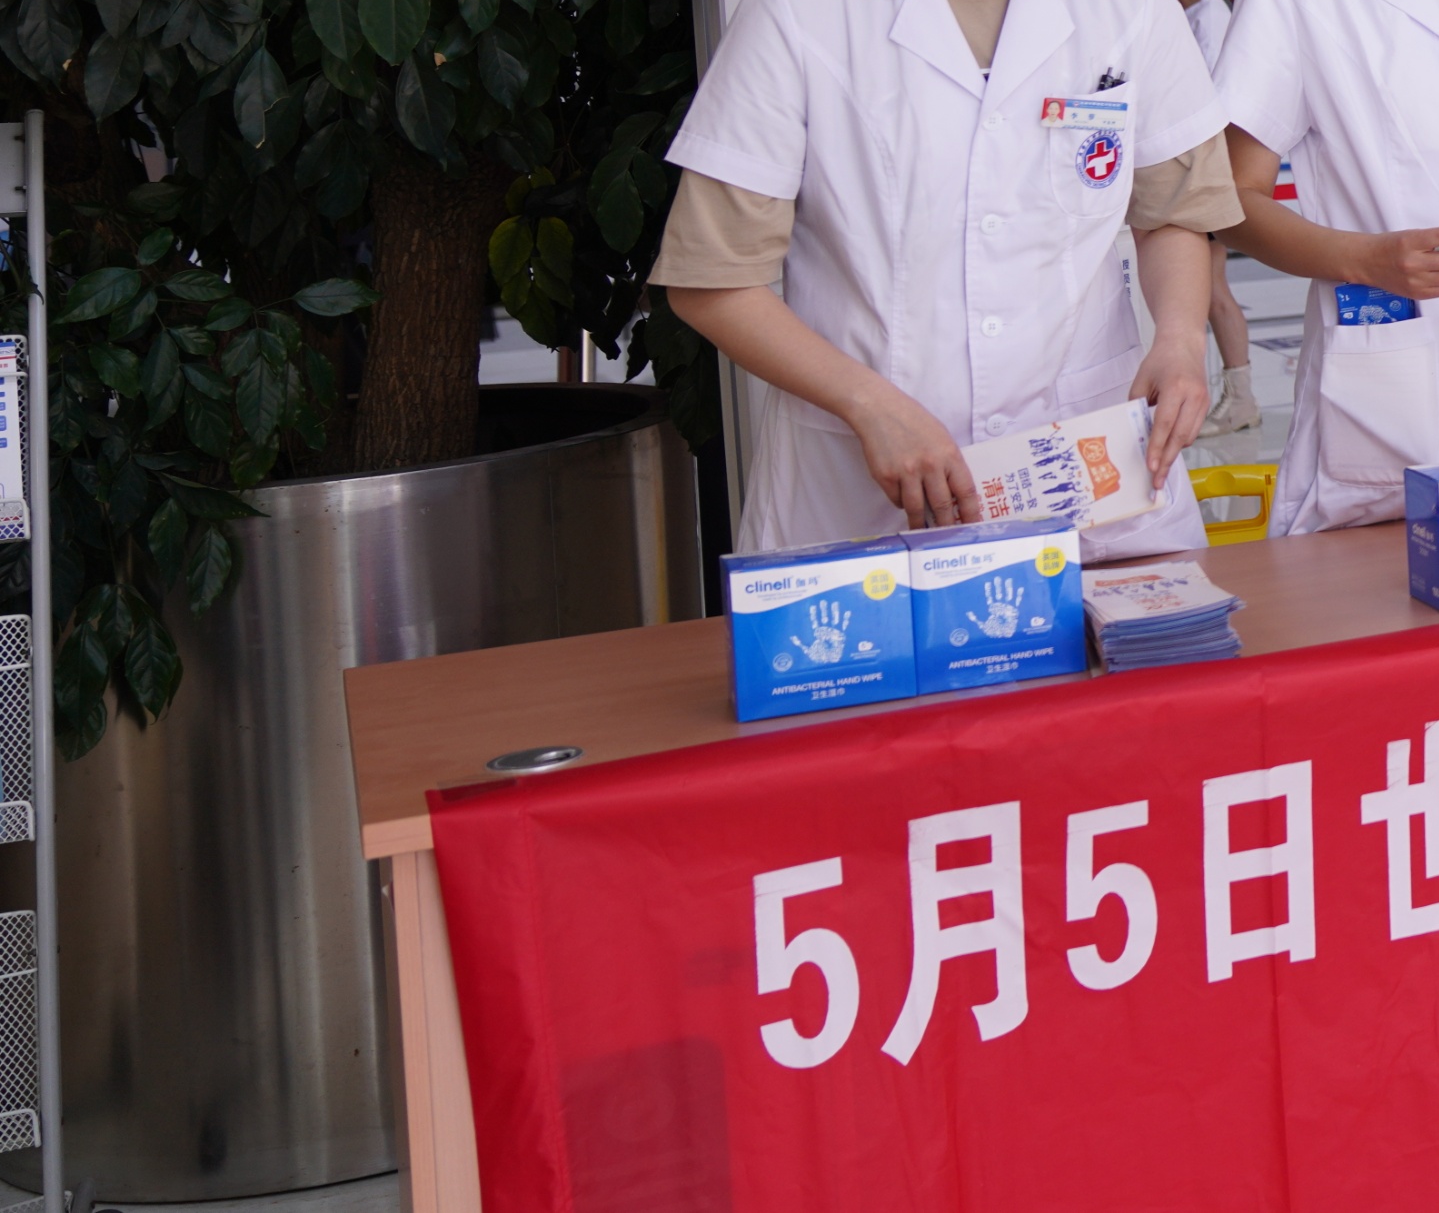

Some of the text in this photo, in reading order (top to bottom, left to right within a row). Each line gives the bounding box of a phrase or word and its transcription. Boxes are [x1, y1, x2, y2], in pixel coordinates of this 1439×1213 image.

[982, 477, 1010, 519] 清洁
[922, 552, 968, 572] clinell
[745, 577, 791, 595] clinell
[948, 646, 1054, 670] ANTIBACTERIAL HAND WIPE
[772, 672, 883, 696] ANTIBACTERIAL HAND WIPE
